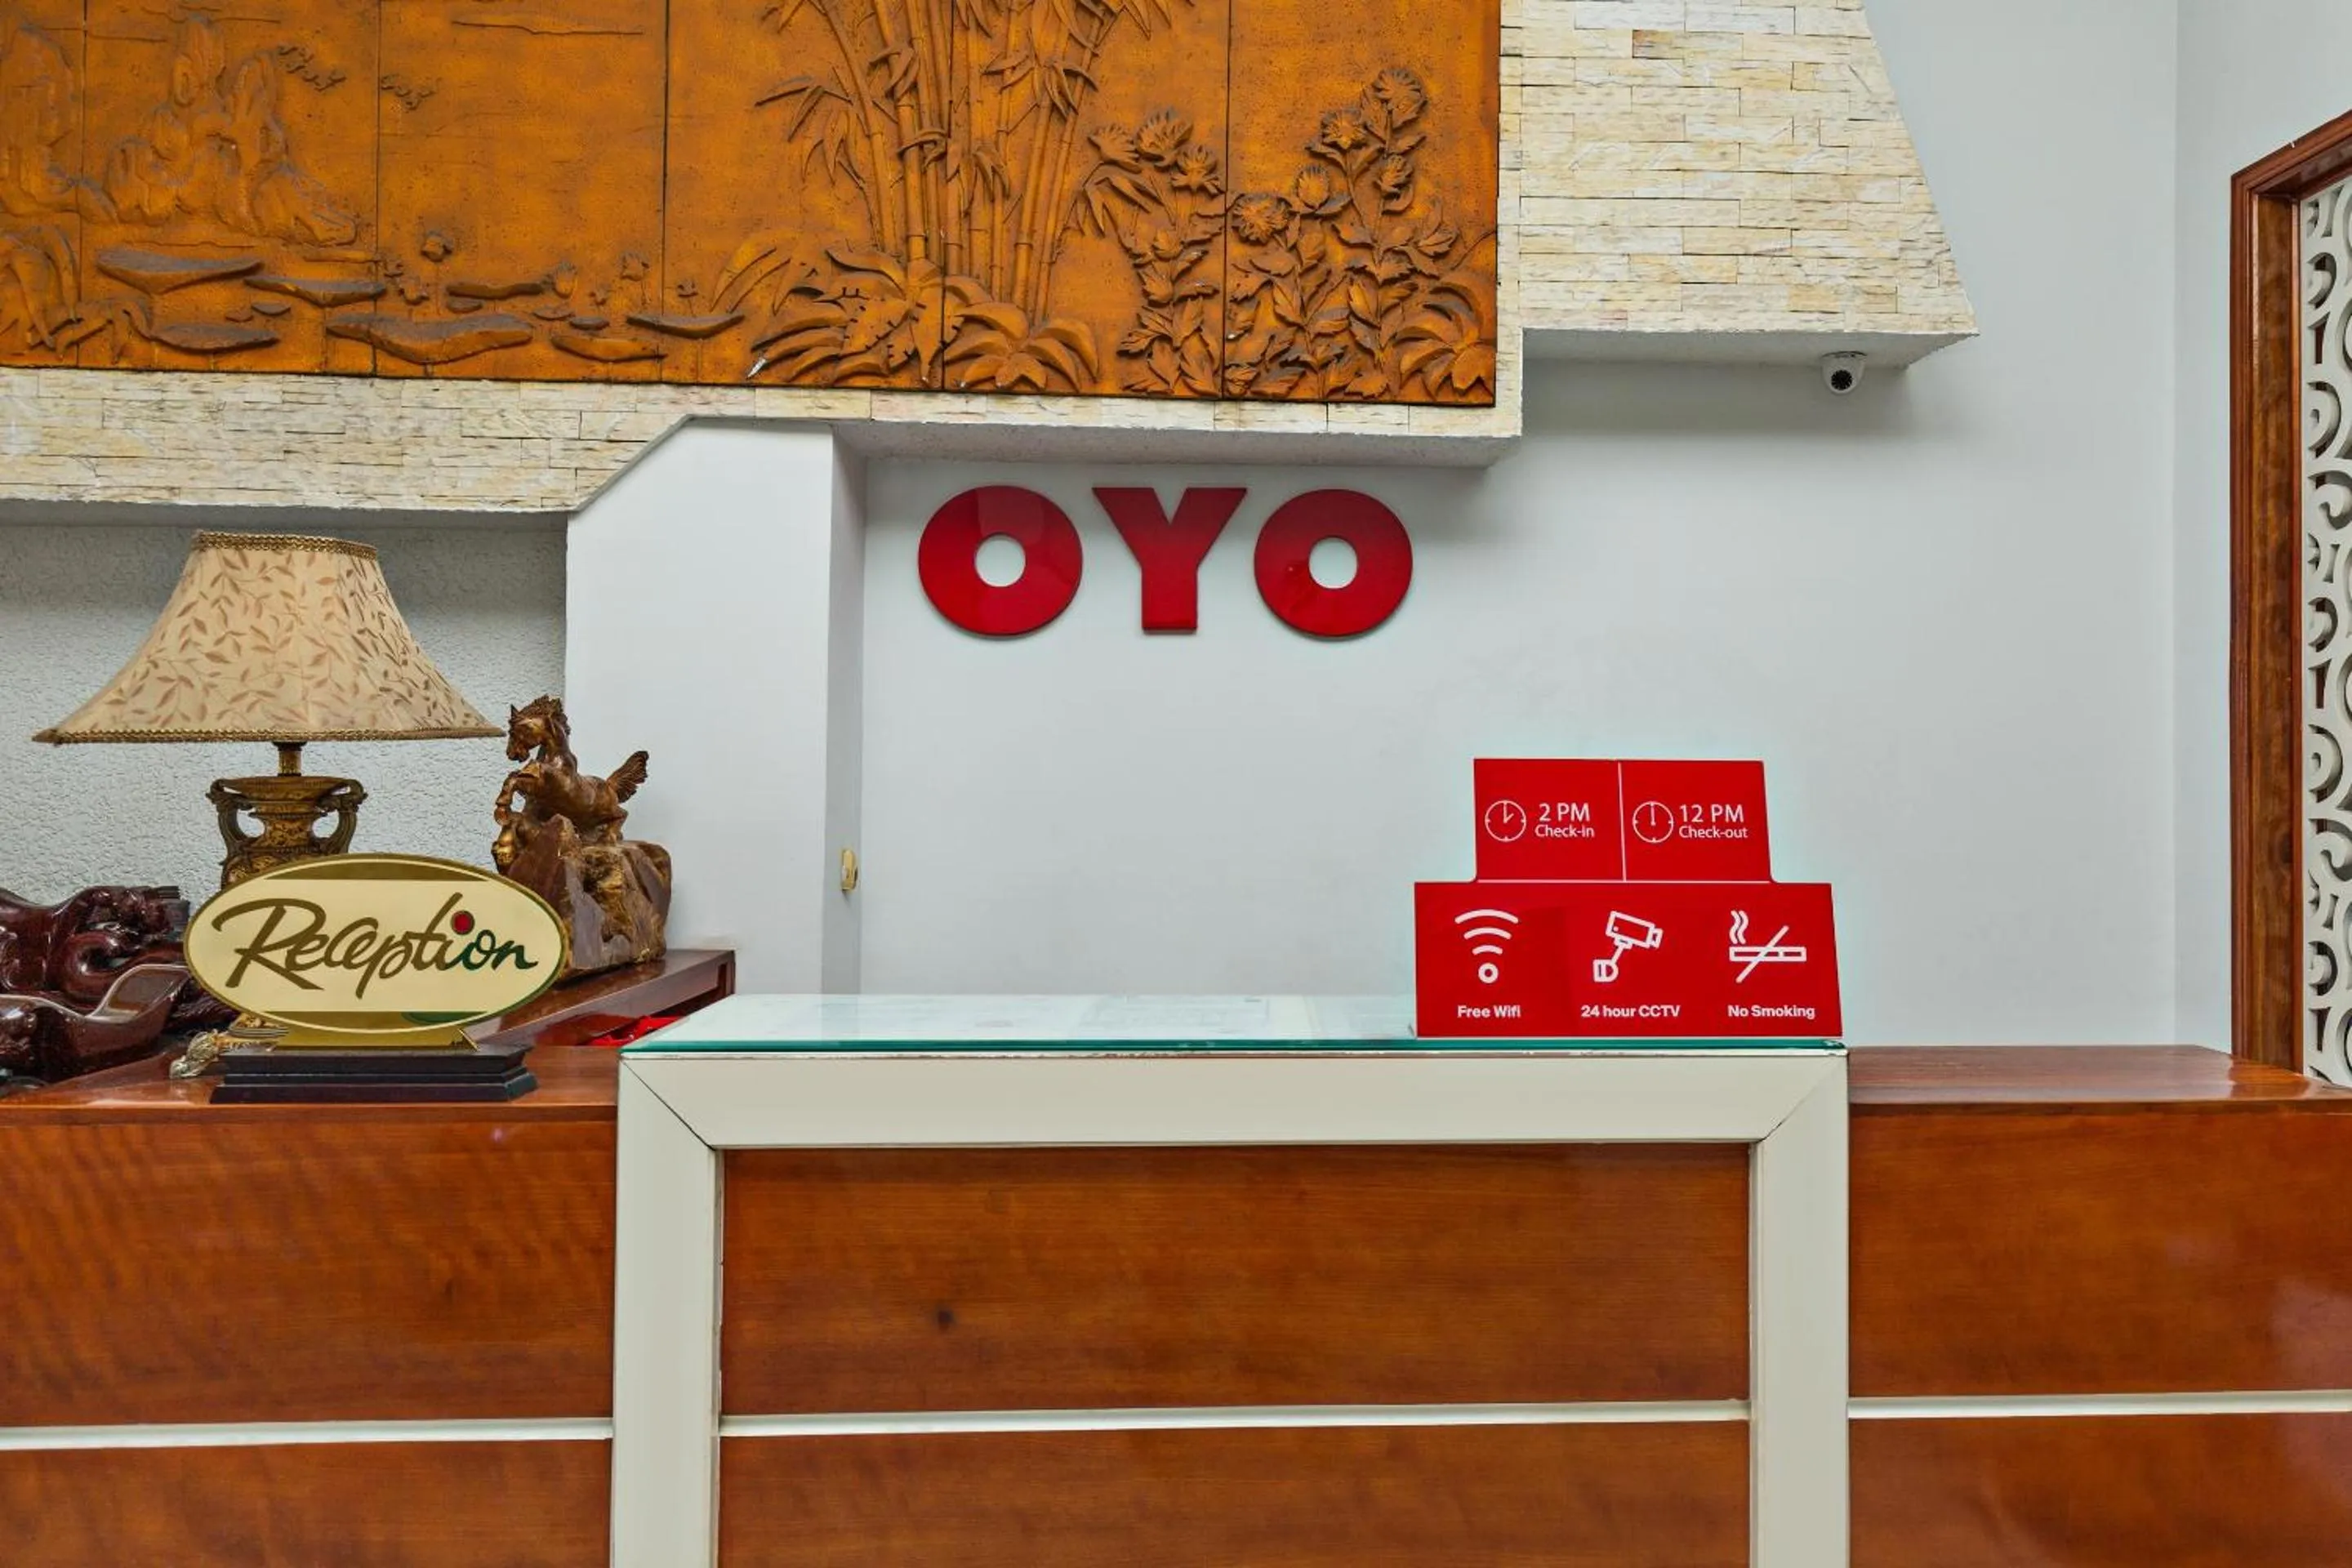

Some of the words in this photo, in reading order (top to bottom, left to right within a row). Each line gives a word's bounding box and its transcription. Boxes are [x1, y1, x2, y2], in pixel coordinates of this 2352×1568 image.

[918, 485, 1413, 639] OYO
[1539, 803, 1550, 822] 2
[1557, 803, 1590, 822] PM
[1680, 804, 1704, 823] 12
[1711, 804, 1744, 823] PM
[1535, 824, 1595, 838] Check-in
[1678, 825, 1748, 840] Check-out
[211, 892, 538, 1000] Reception
[1457, 1004, 1490, 1018] Free
[1493, 1004, 1521, 1018] Wifi
[1580, 1004, 1600, 1018] 24
[1601, 1004, 1637, 1018] hour
[1638, 1004, 1681, 1018] CCTV
[1727, 1004, 1748, 1018] No
[1750, 1004, 1815, 1020] Smoking
